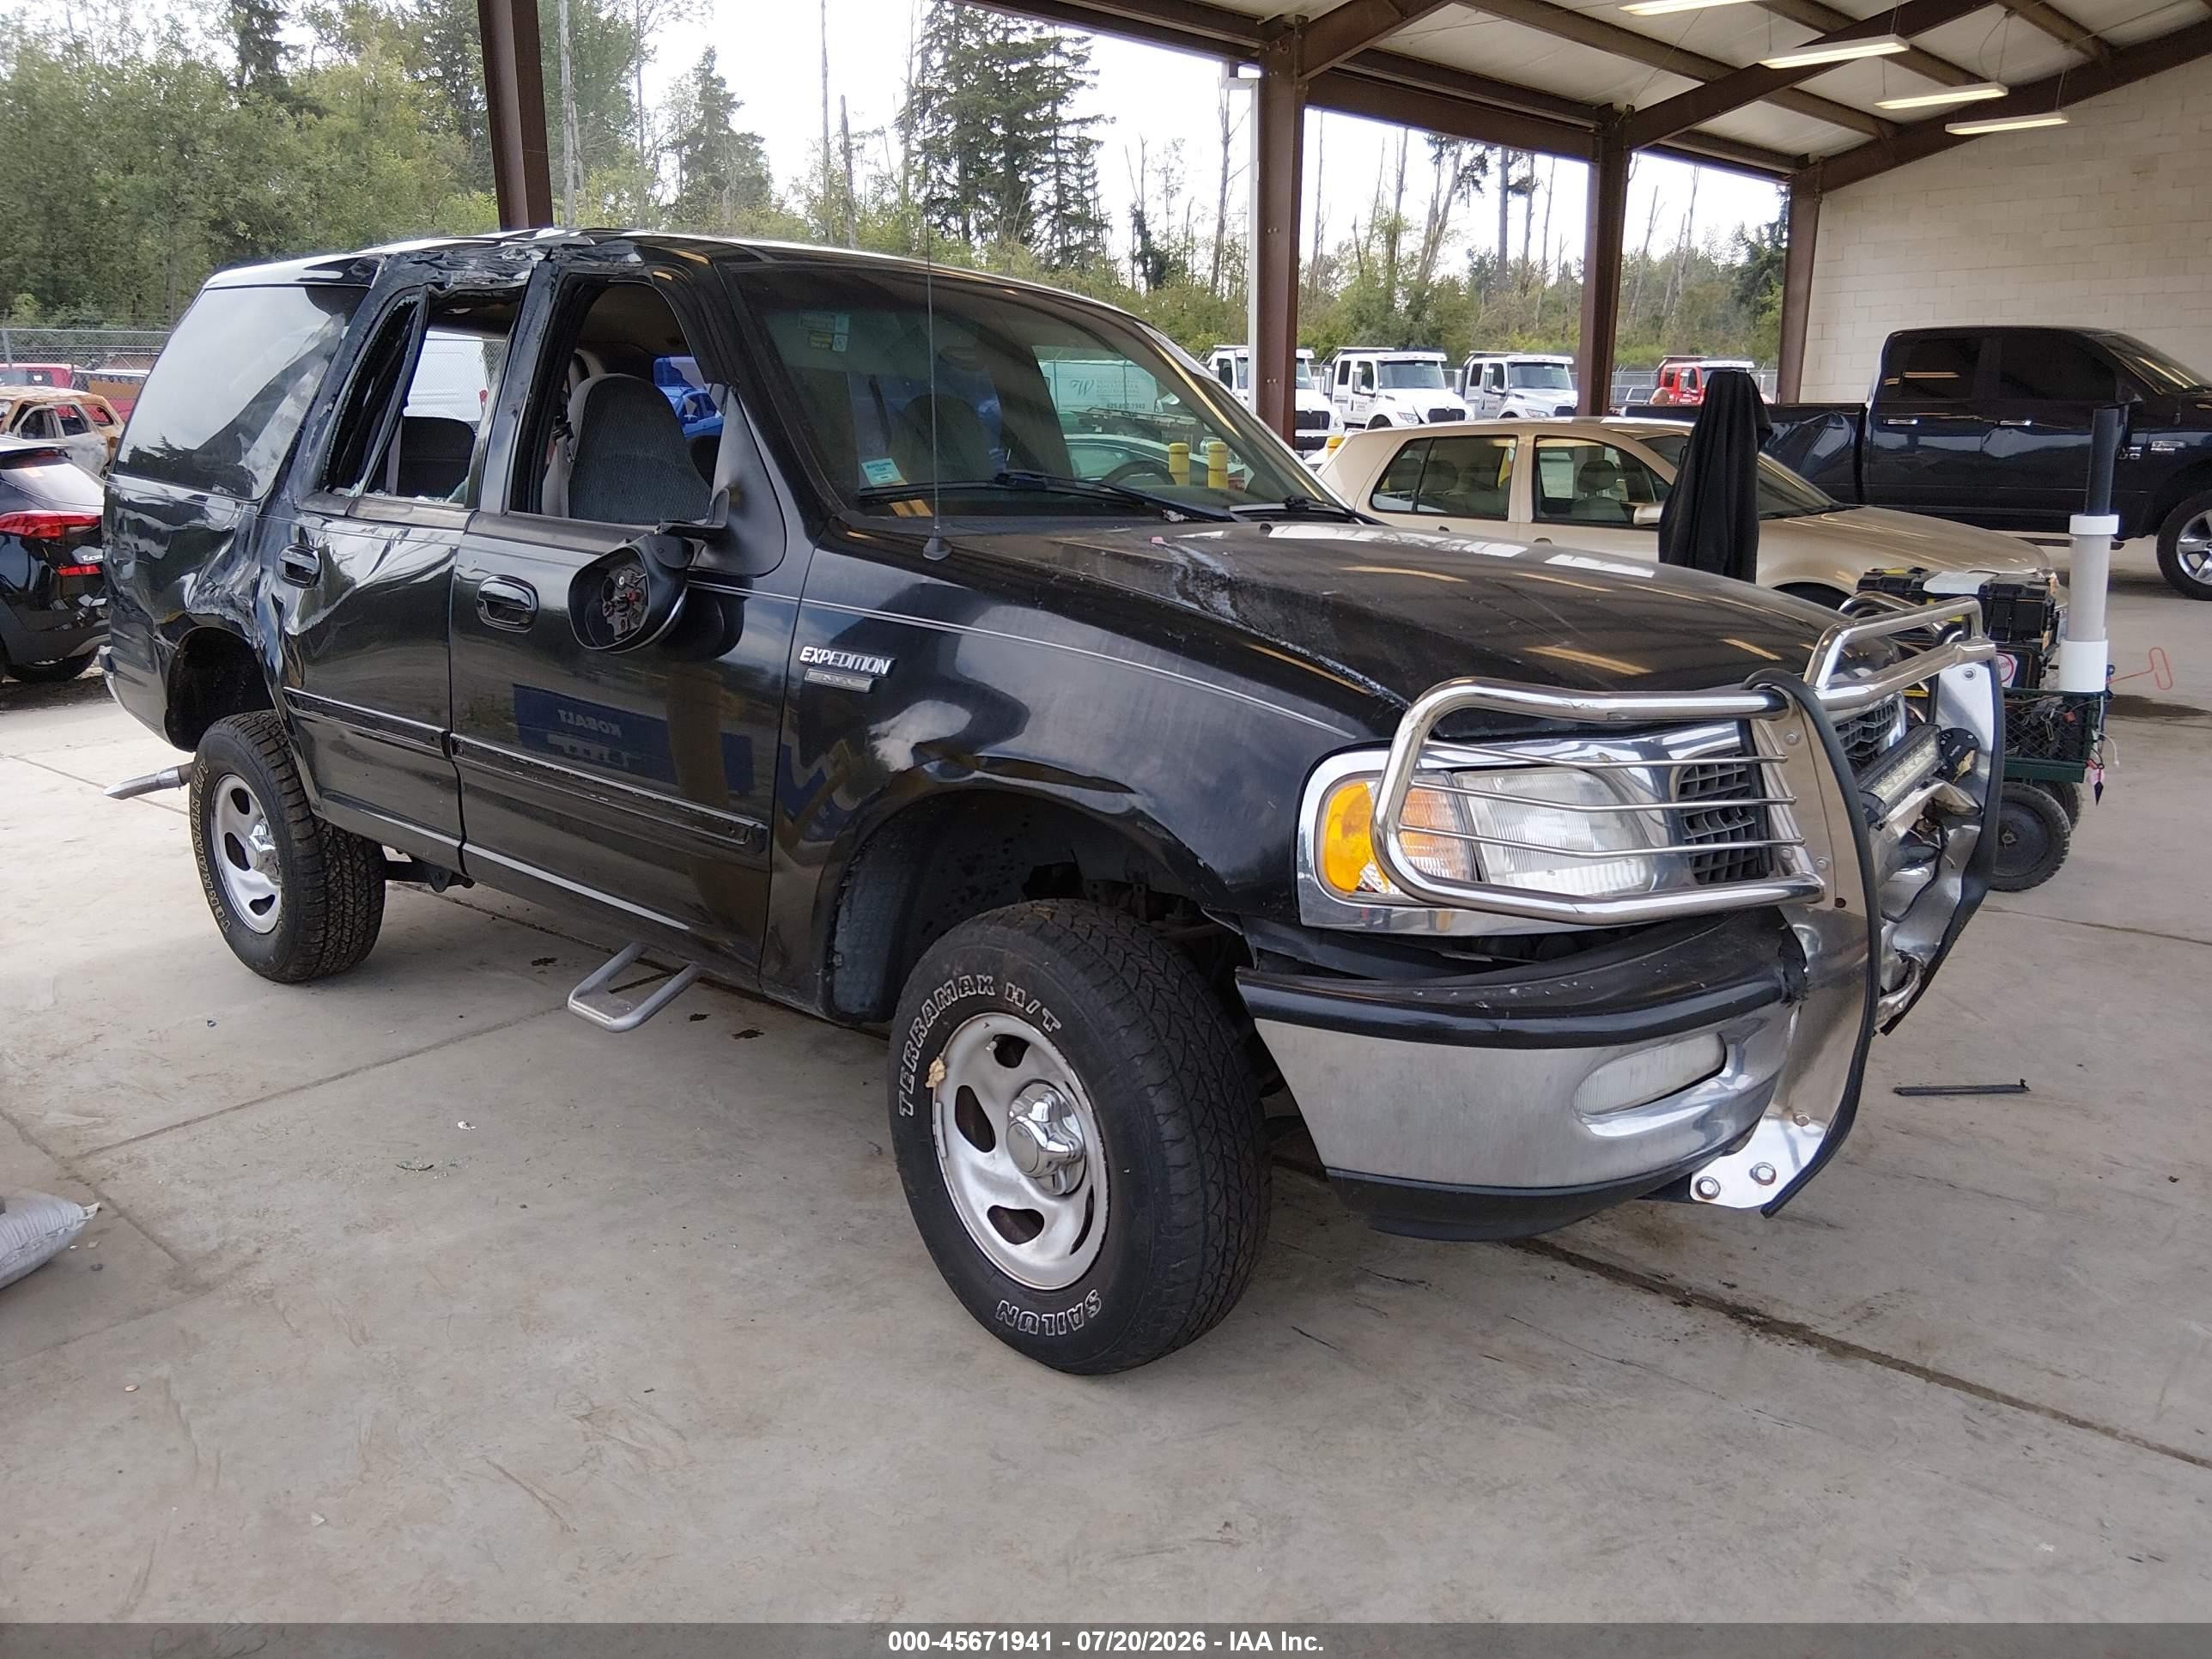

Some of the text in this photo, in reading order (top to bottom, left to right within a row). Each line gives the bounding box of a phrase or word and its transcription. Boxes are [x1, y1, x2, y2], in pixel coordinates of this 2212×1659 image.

[799, 646, 891, 675] EXPEDITION
[899, 974, 1061, 1116] TERRAMAX H/T
[995, 1289, 1101, 1336] SAILUN
